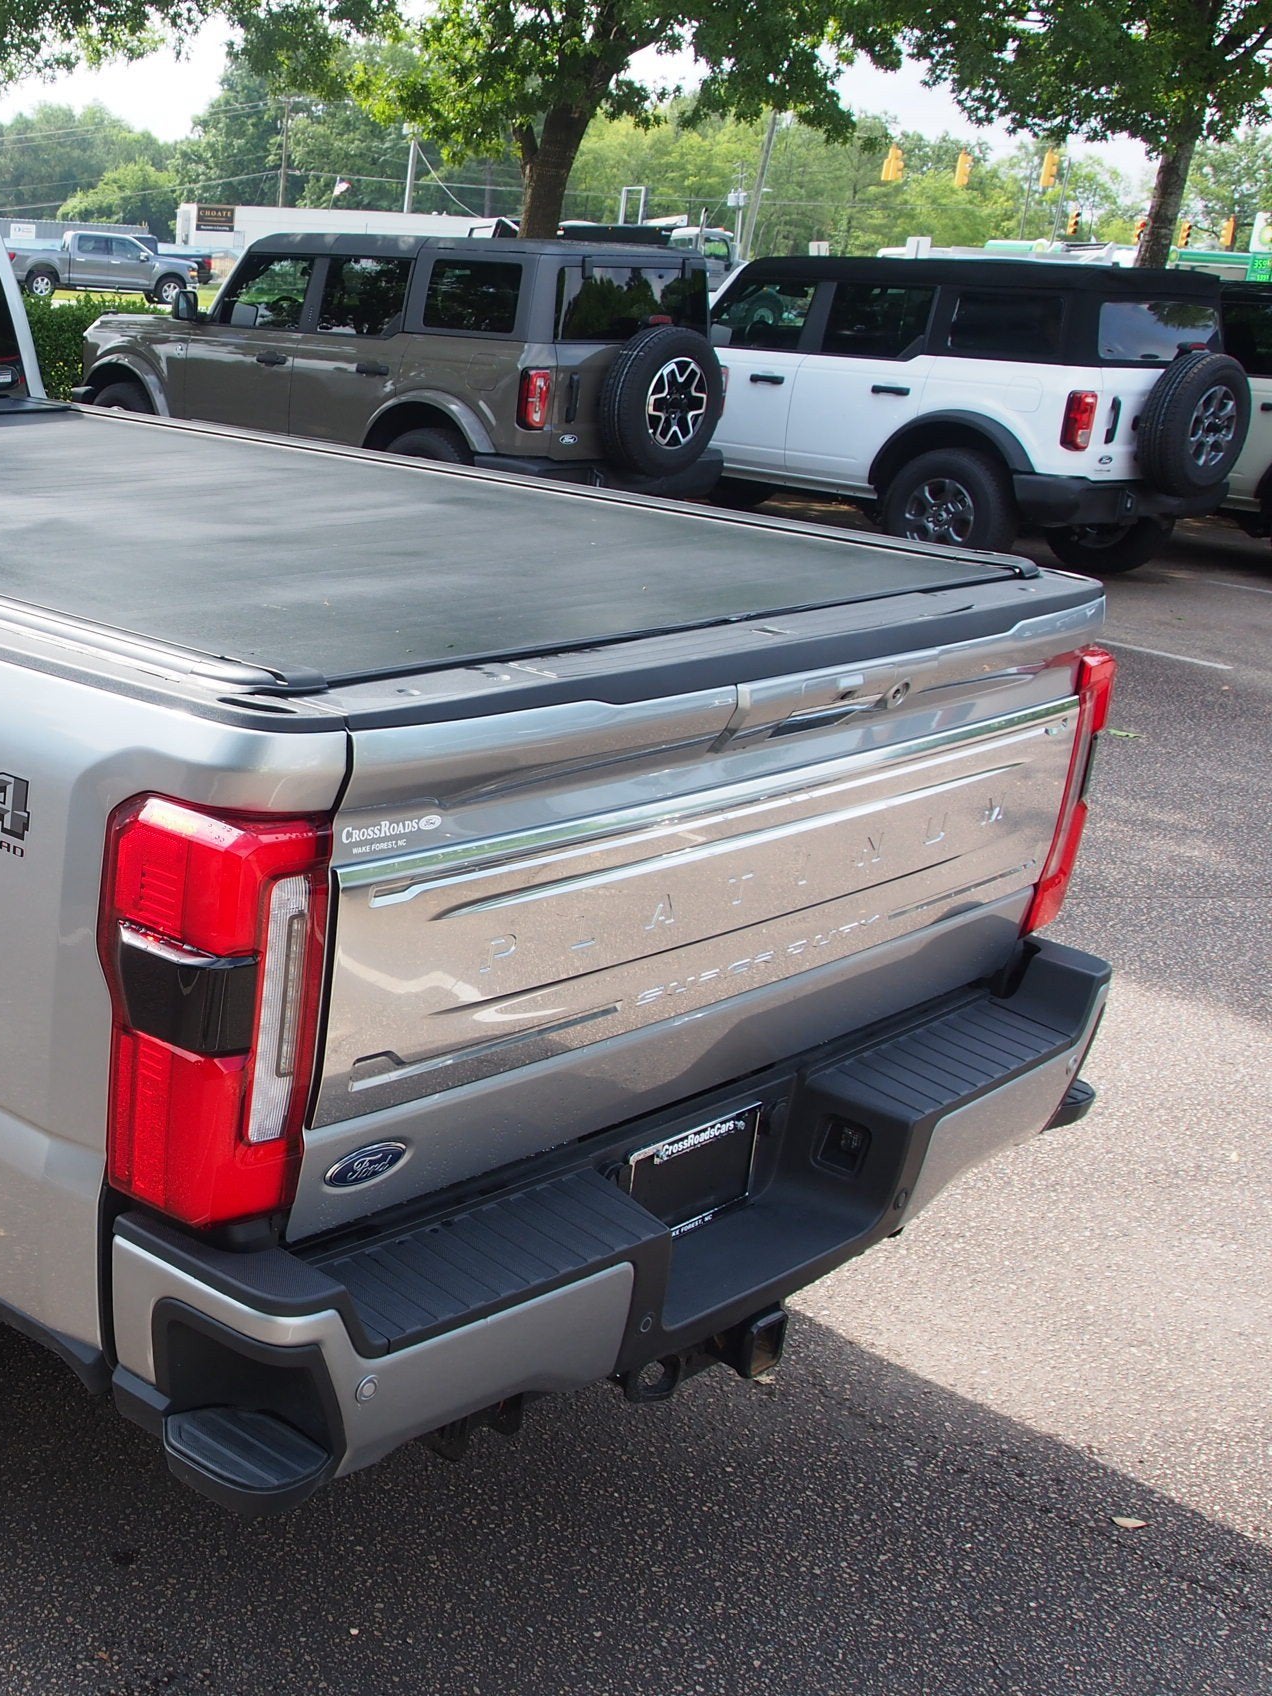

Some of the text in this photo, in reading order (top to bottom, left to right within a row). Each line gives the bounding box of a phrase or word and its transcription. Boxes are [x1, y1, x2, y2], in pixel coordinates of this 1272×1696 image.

[352, 845, 370, 854] WAKE
[371, 841, 397, 852] FOREST,
[347, 1153, 392, 1180] Ford
